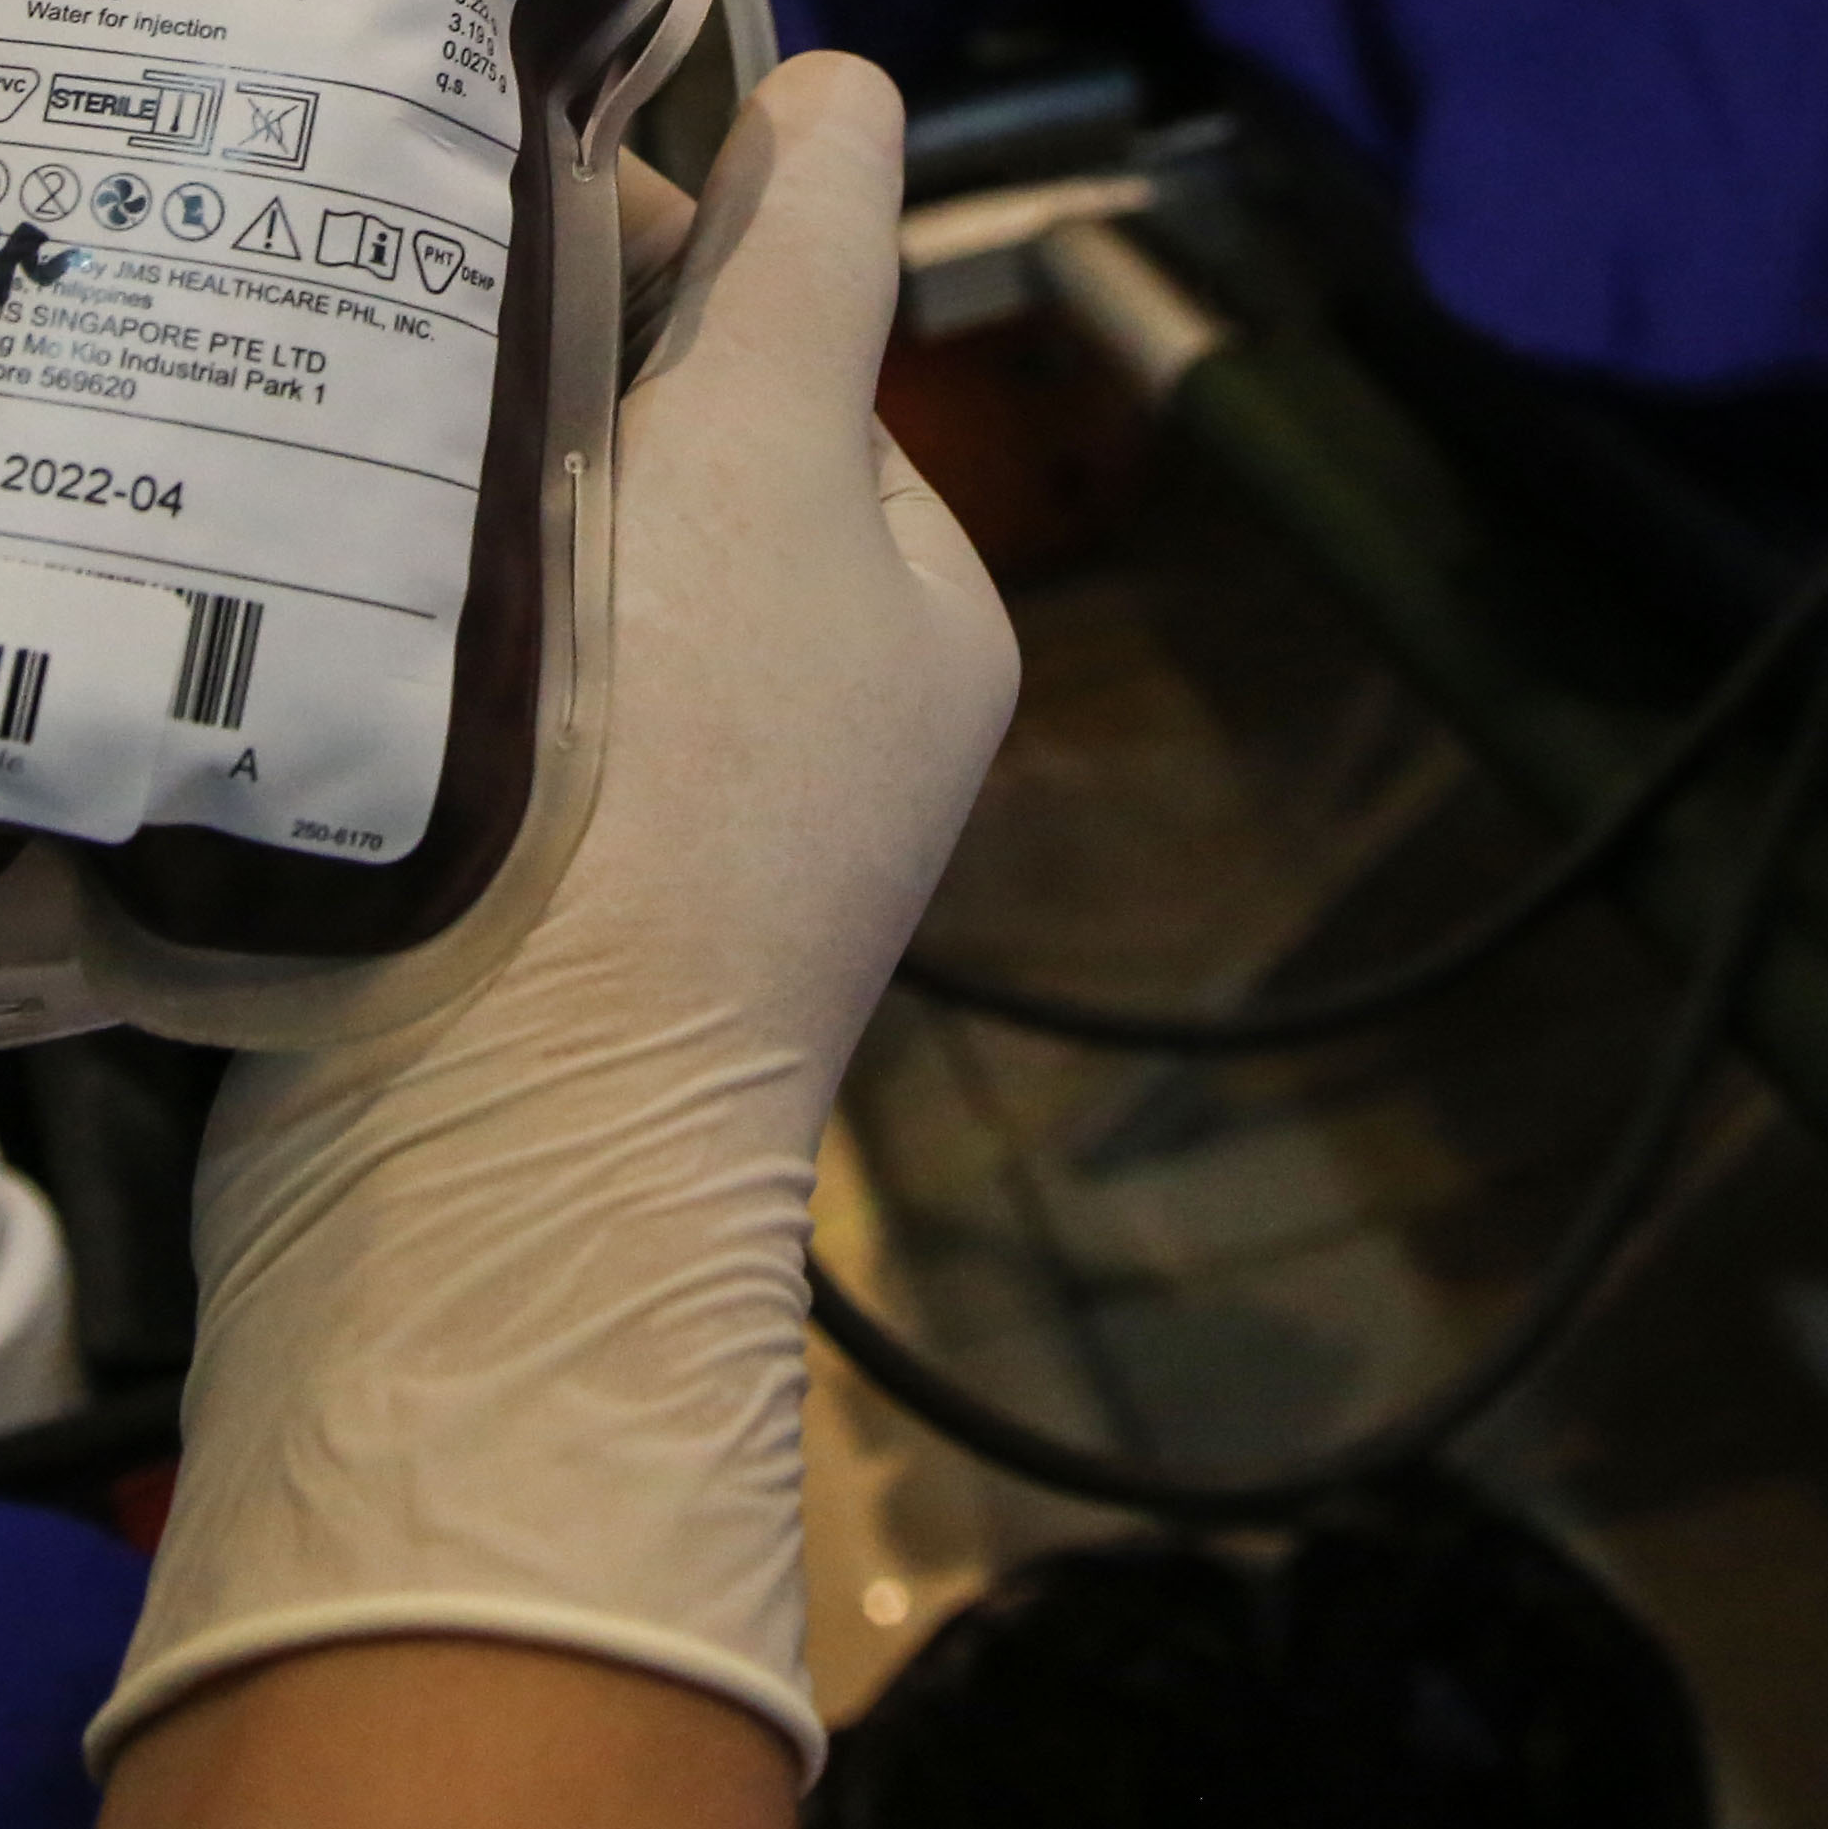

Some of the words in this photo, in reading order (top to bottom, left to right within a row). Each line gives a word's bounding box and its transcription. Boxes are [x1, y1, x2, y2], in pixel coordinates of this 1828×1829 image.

[26, 0, 92, 25] Water
[98, 6, 129, 29] for
[133, 11, 228, 41] injection
[442, 39, 498, 82] 0.0275
[50, 87, 158, 122] STERILE
[436, 71, 468, 98] q.s.
[423, 244, 456, 267] PHT
[461, 264, 496, 292] DEHP
[112, 260, 161, 285] JMS
[169, 270, 330, 316] HEALTHCARE
[335, 298, 386, 331] PHL,
[392, 312, 436, 342] INC.
[31, 304, 201, 350] SINGAPORE
[208, 331, 265, 363] PTE
[272, 344, 328, 374] LTD
[23, 332, 66, 359] Mo
[71, 340, 113, 367] Kio
[119, 346, 237, 388] Industrial
[243, 371, 303, 402] Park
[313, 382, 327, 406] 1
[39, 365, 137, 400] 569620
[229, 747, 259, 782] A
